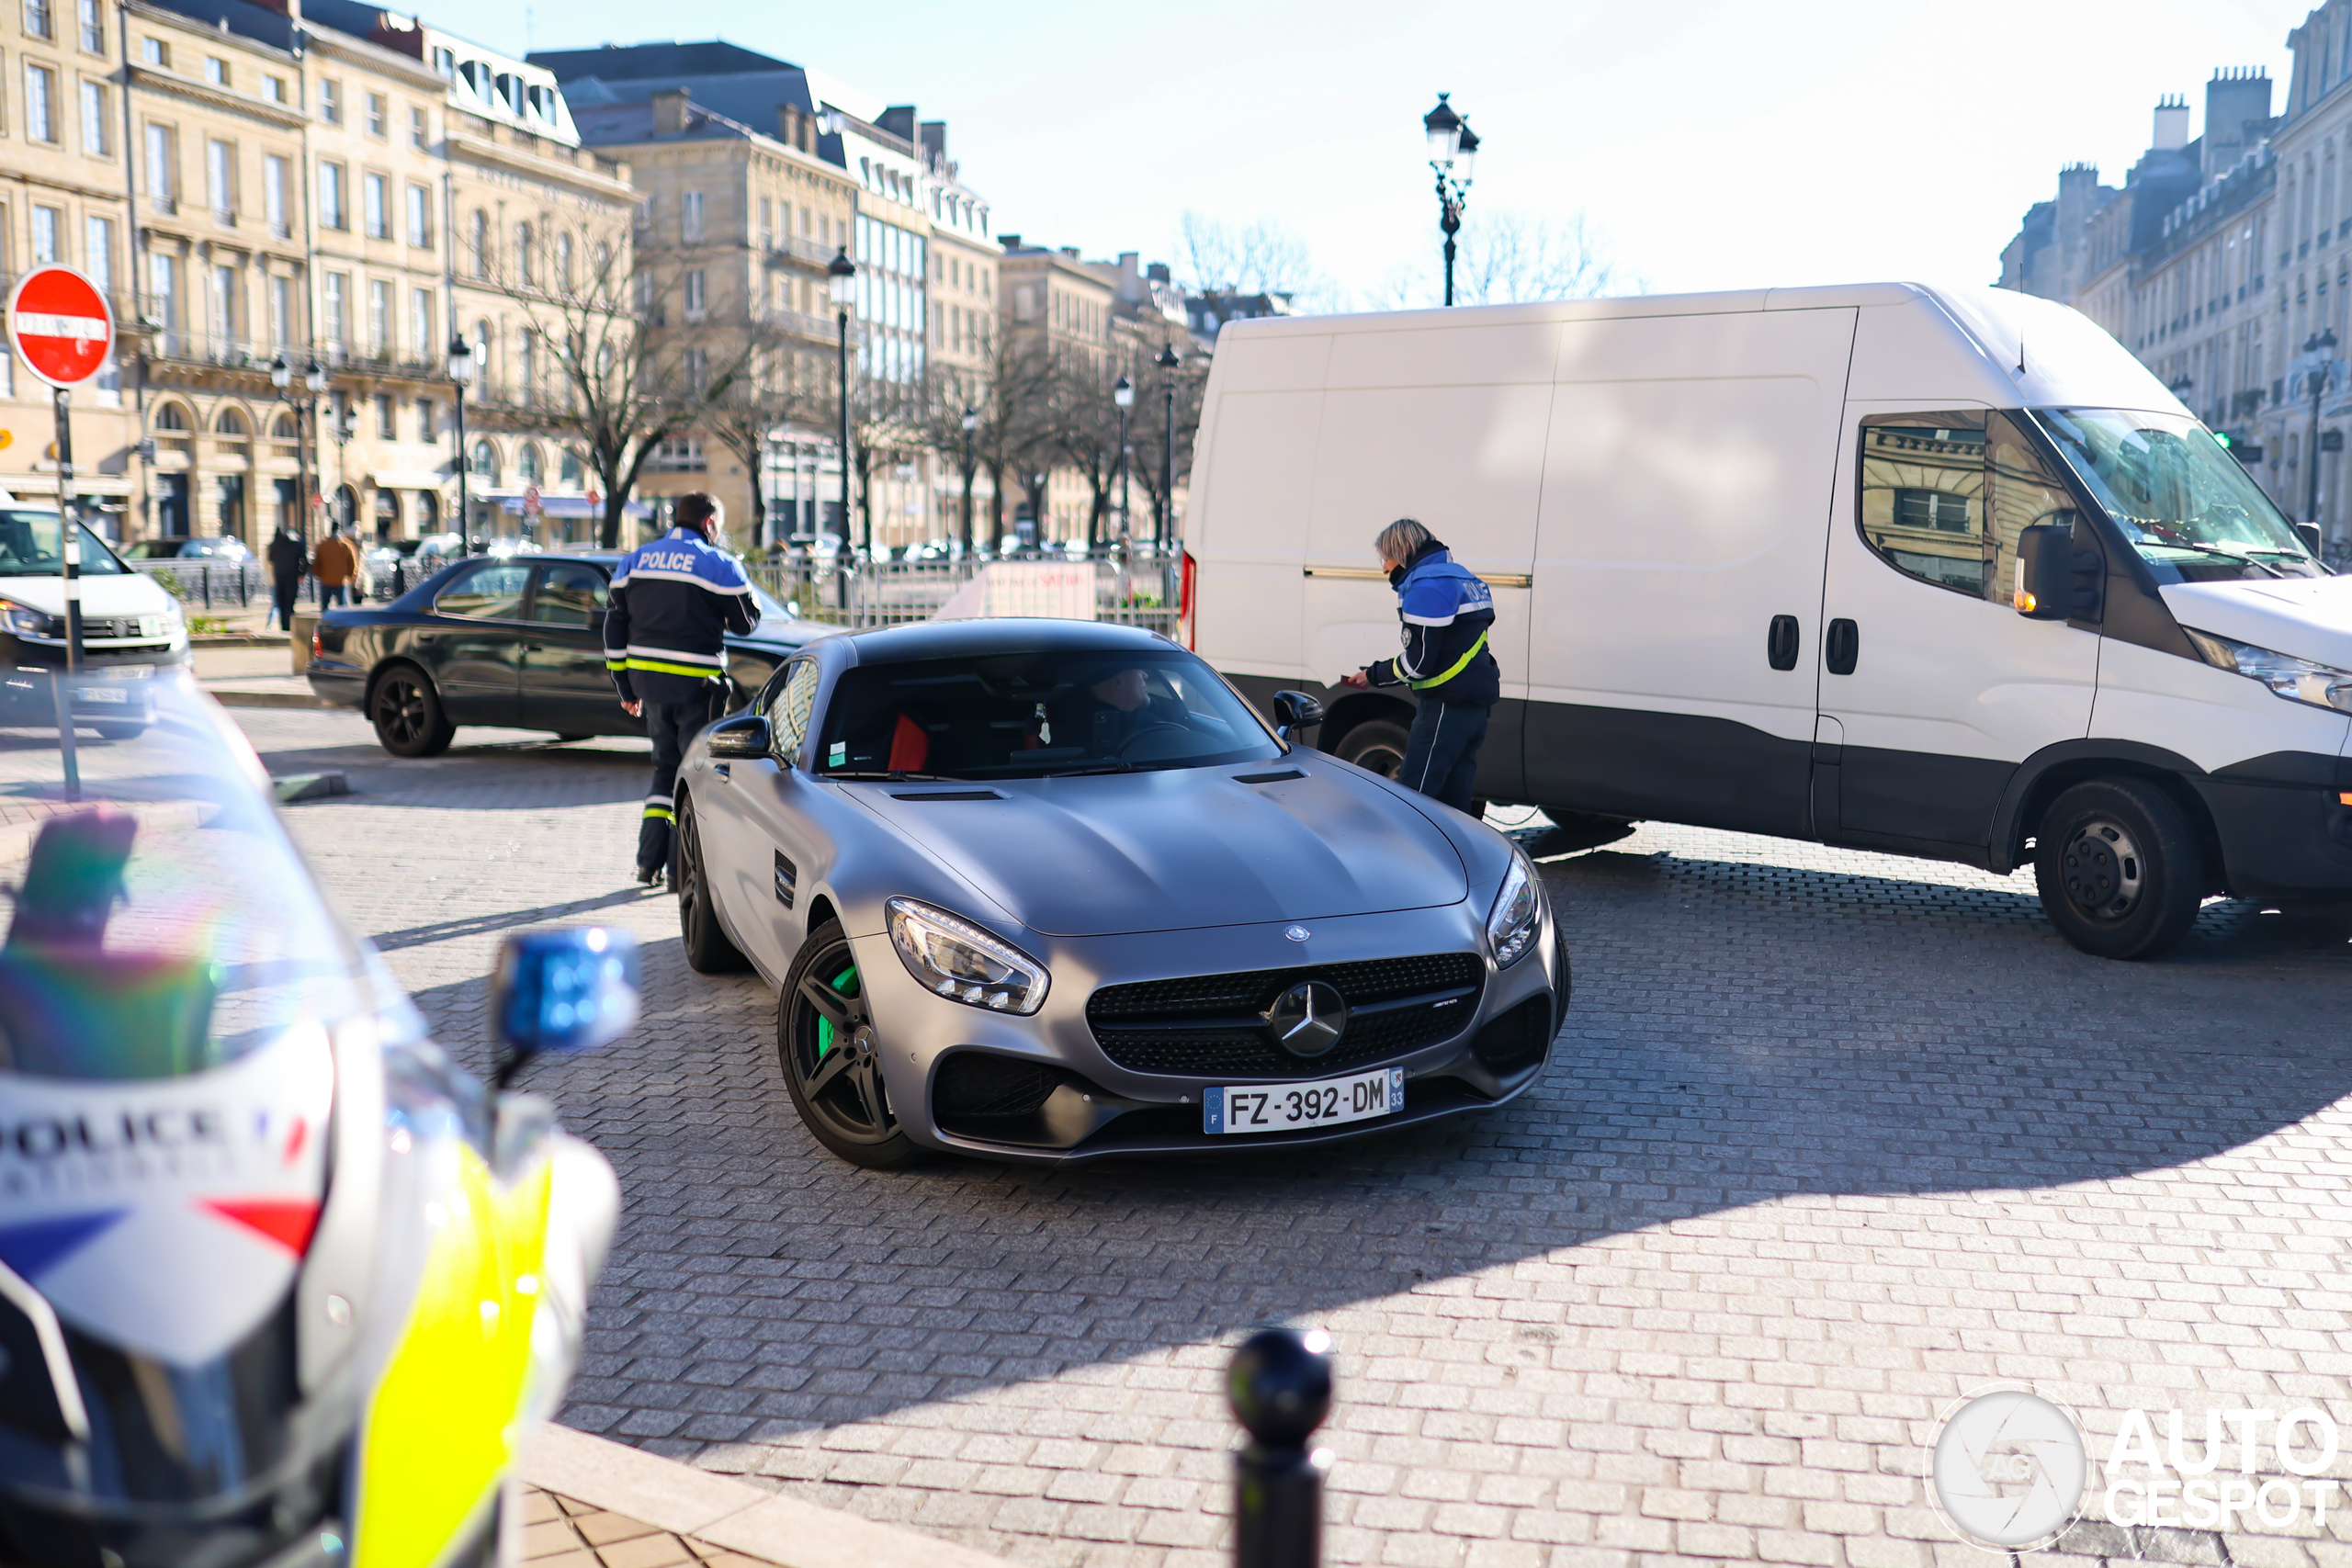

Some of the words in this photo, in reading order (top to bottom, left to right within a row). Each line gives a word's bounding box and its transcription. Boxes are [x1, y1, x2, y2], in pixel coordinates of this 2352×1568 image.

[637, 551, 696, 572] POLICE
[1211, 1114, 1217, 1124] F
[1230, 1077, 1384, 1125] FZ-392-DM
[1391, 1091, 1403, 1107] 33
[0, 1110, 226, 1160] OLICE
